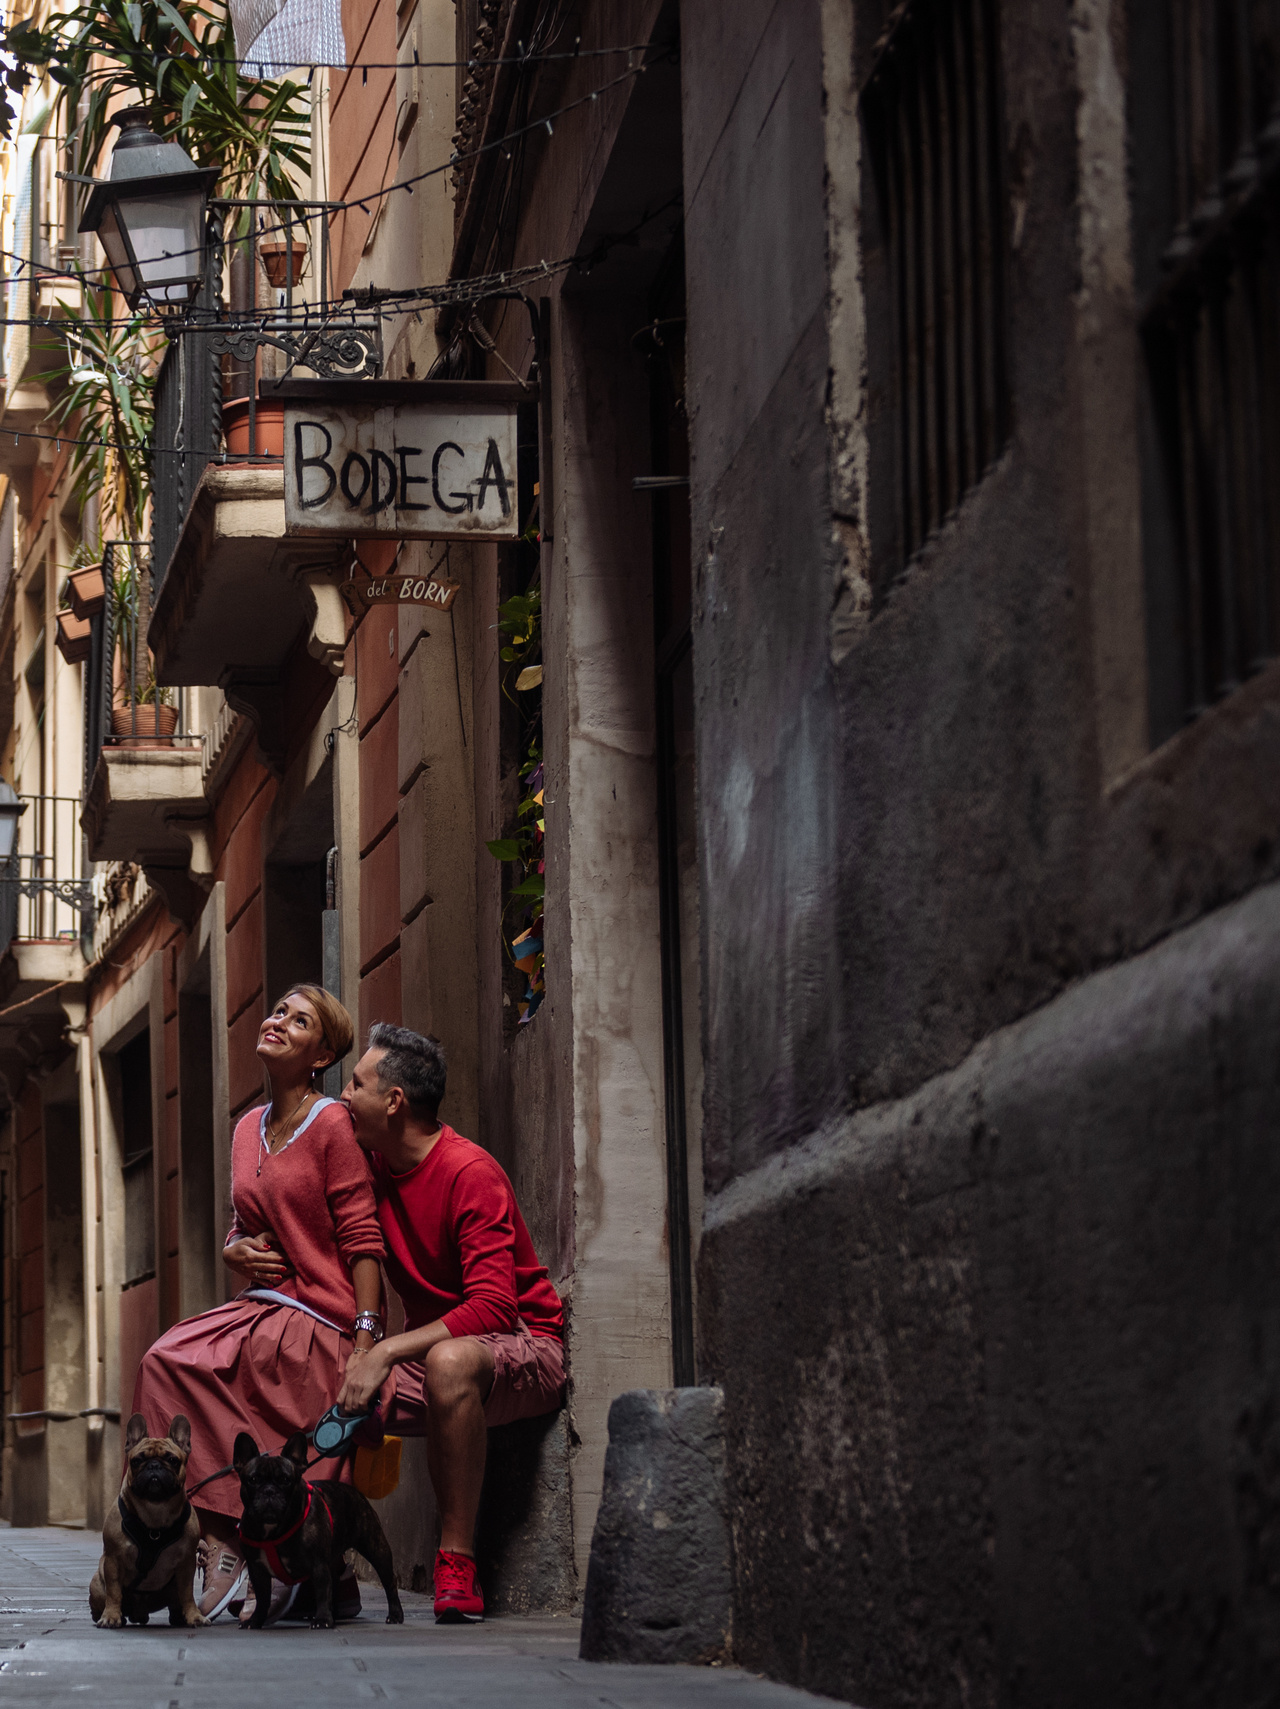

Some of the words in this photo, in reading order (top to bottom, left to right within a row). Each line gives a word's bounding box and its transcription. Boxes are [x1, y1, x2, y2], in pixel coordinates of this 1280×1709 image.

[294, 421, 515, 518] BODEGA
[366, 579, 387, 598] del
[398, 577, 452, 605] BORN
